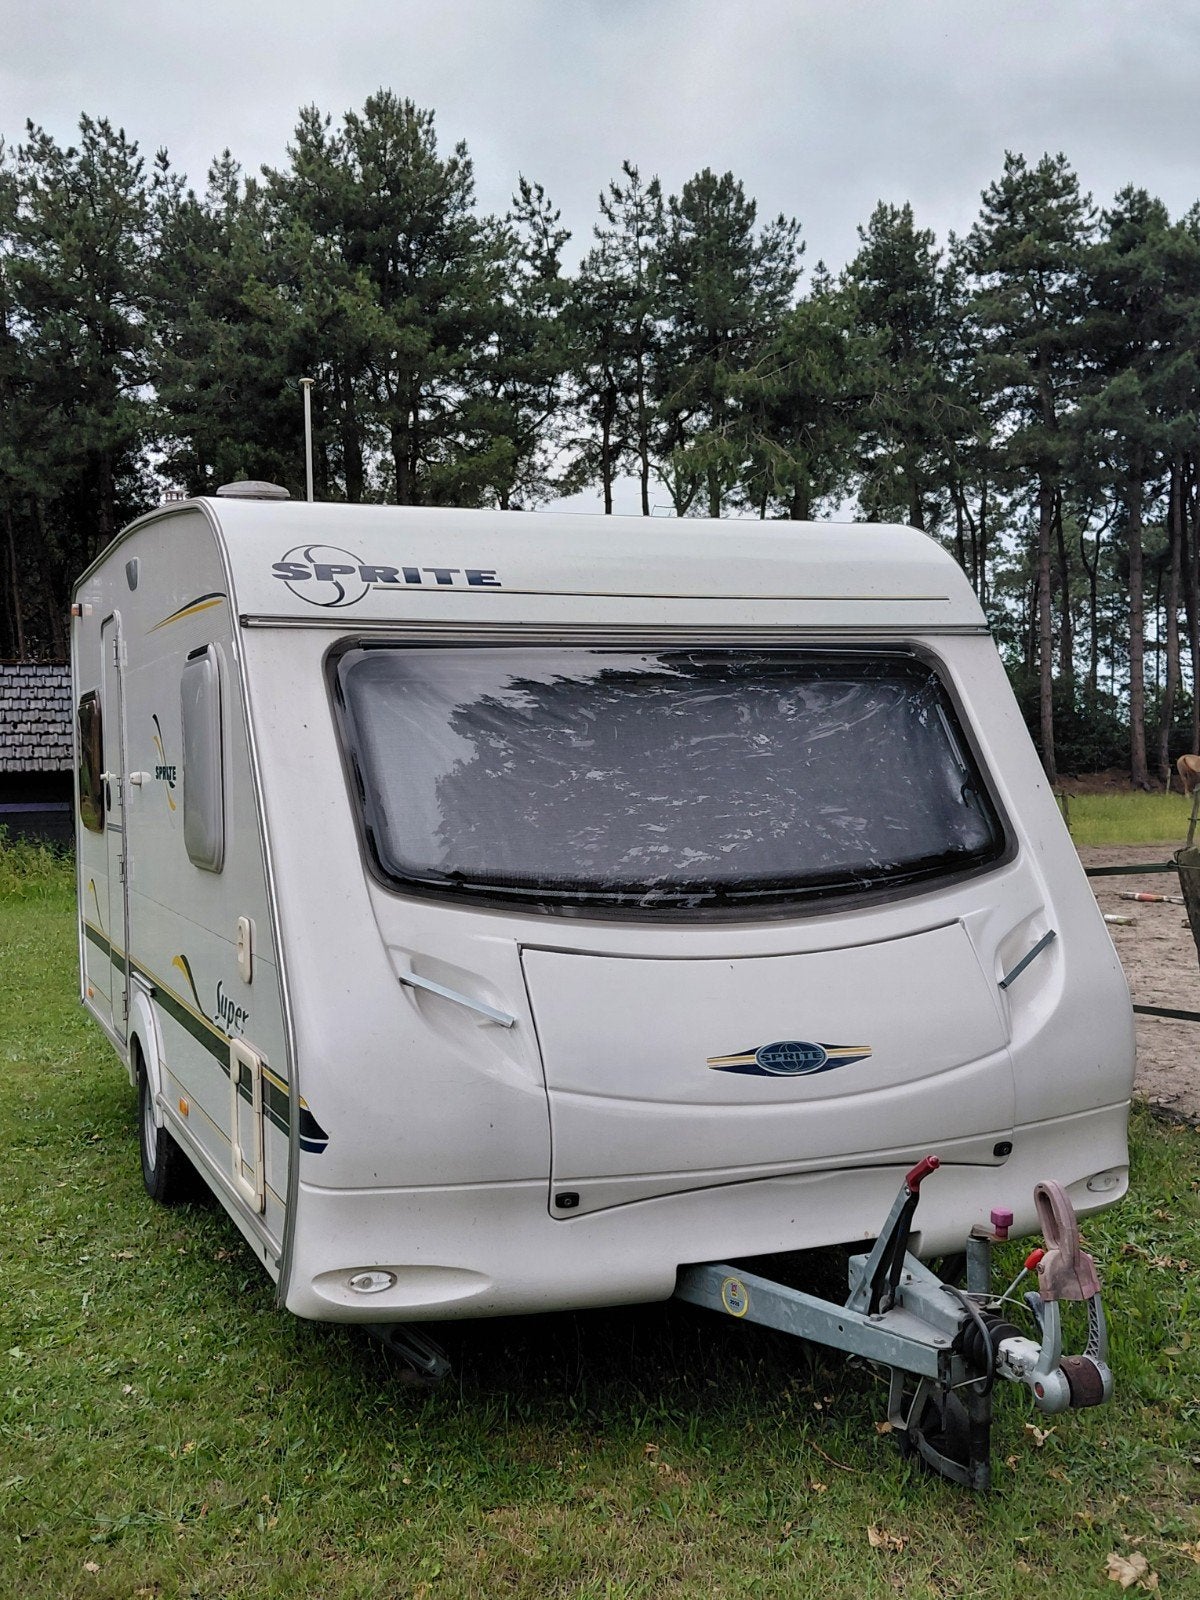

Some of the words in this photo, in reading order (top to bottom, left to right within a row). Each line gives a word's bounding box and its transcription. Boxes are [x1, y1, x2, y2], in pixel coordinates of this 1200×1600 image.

[271, 562, 502, 587] SPRITE
[155, 766, 176, 780] SPRITE
[214, 980, 249, 1034] Super
[760, 1051, 823, 1062] SPRITE
